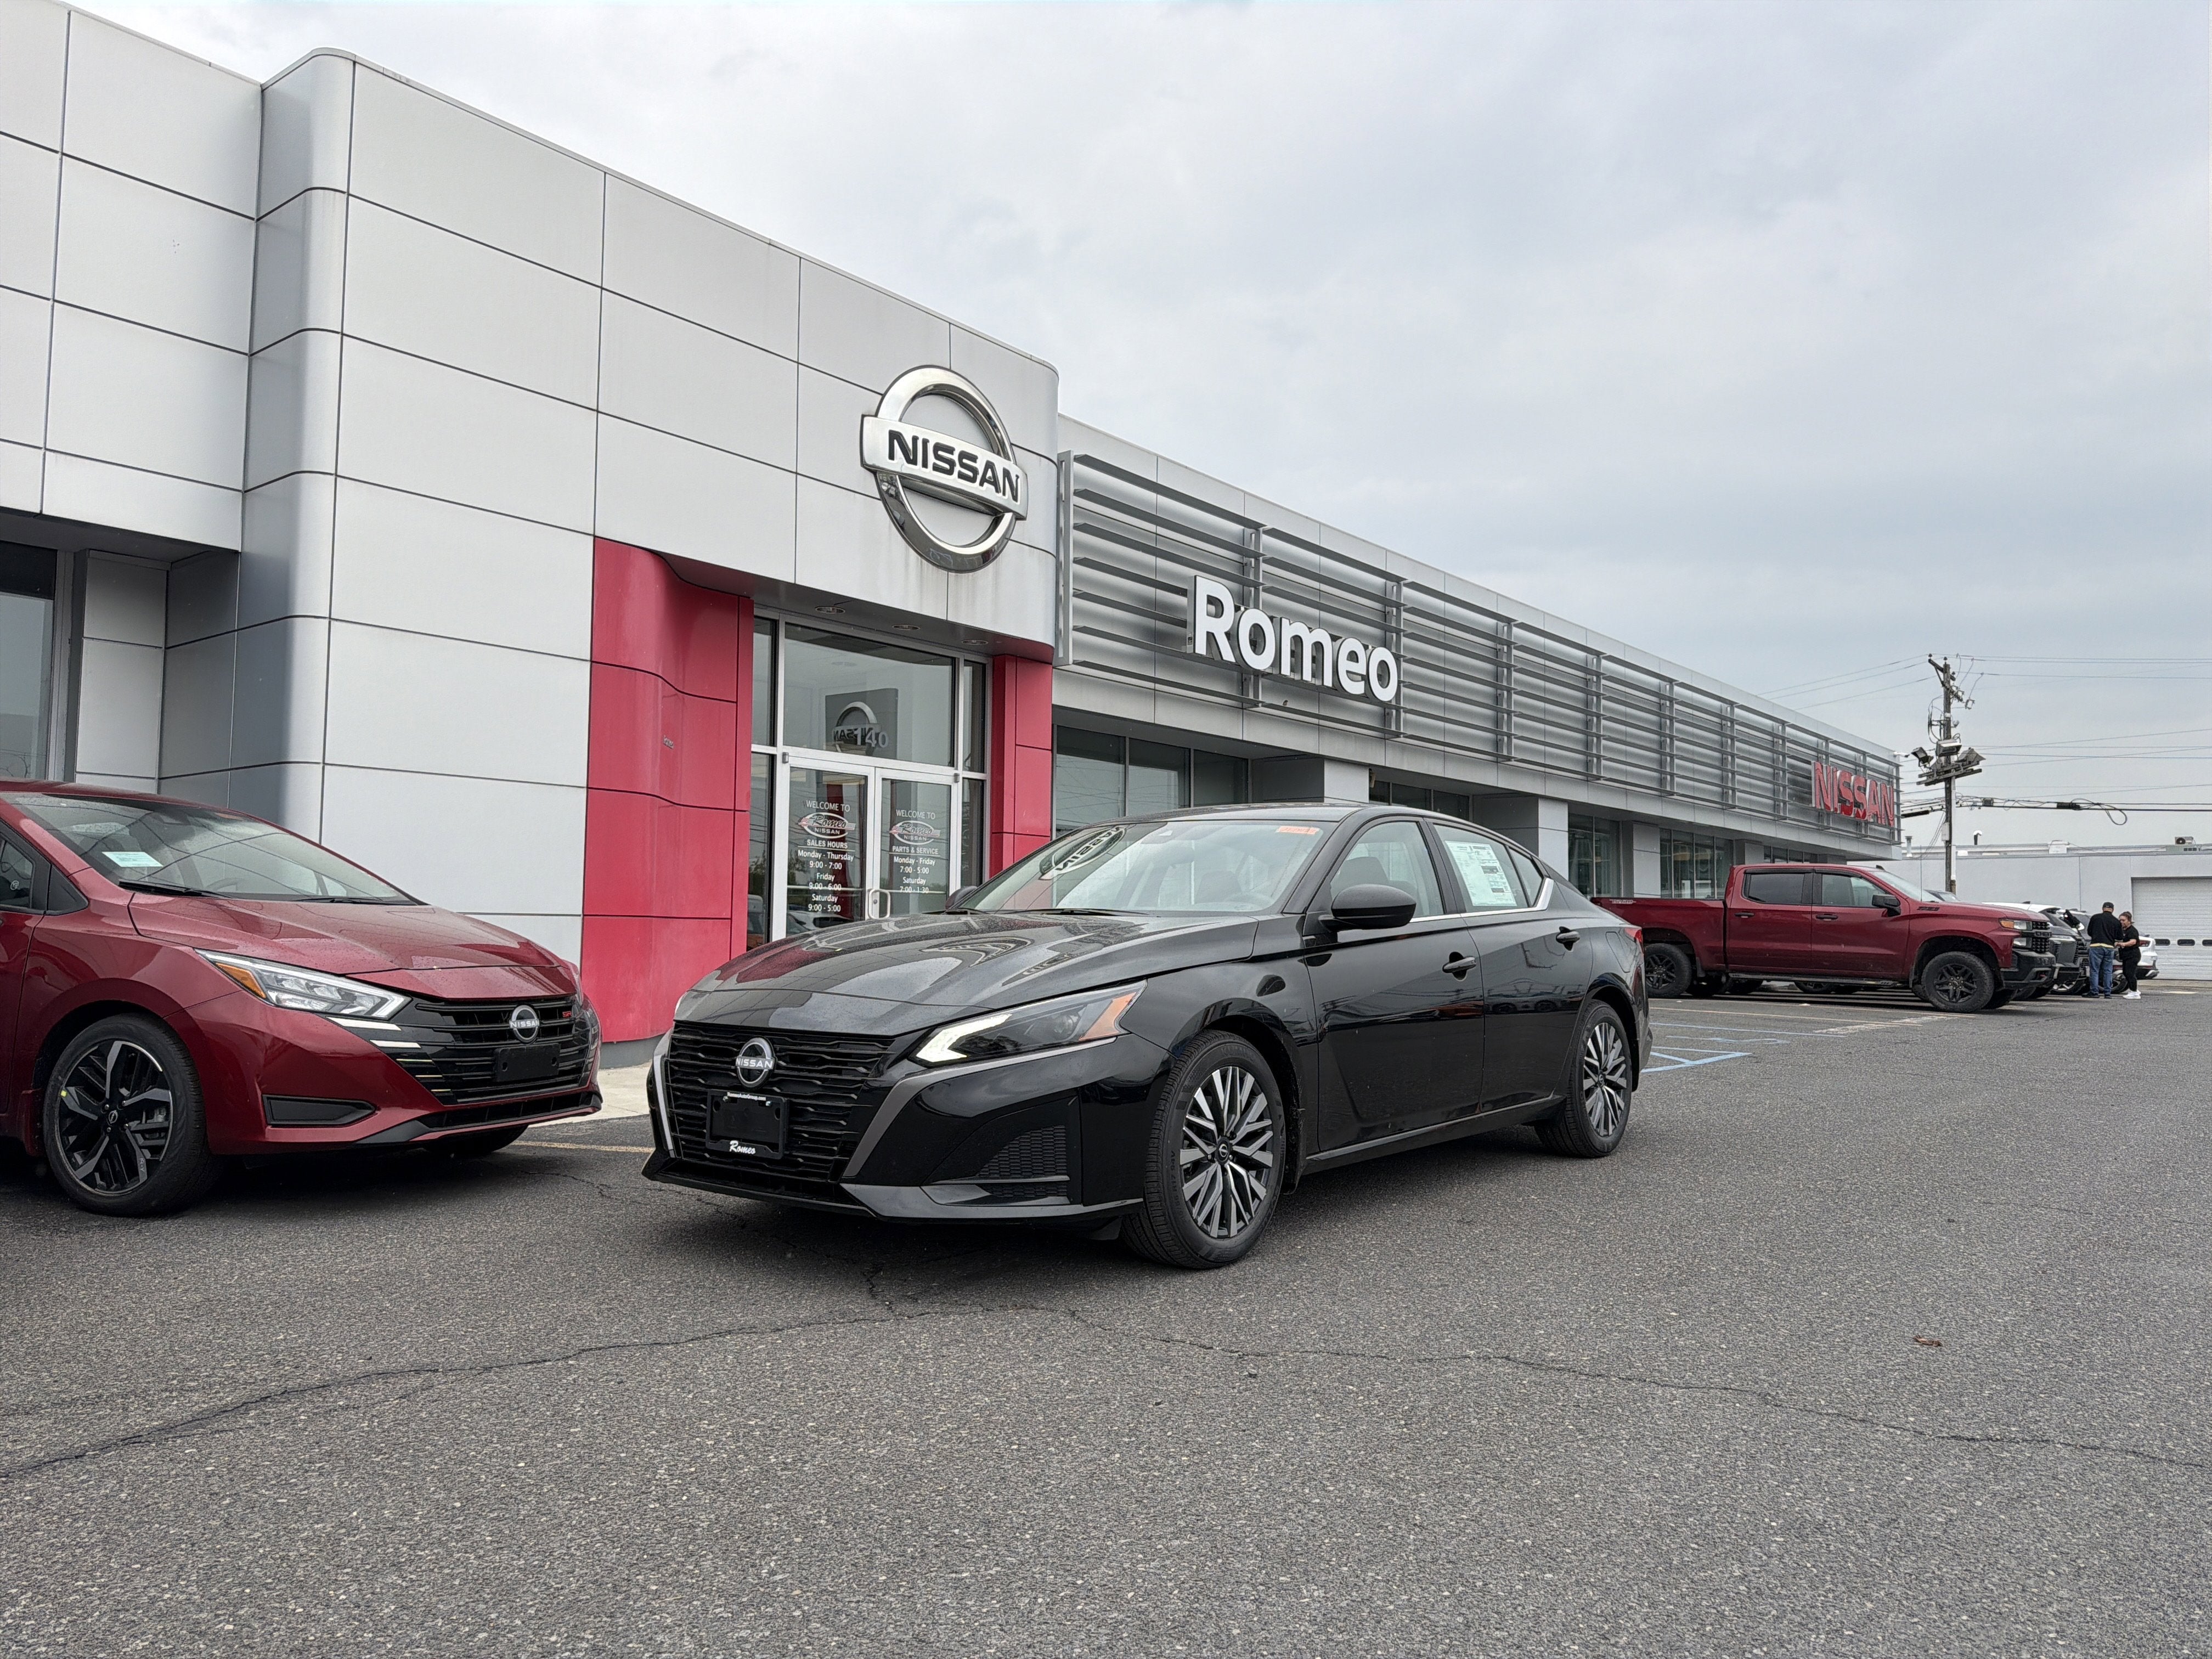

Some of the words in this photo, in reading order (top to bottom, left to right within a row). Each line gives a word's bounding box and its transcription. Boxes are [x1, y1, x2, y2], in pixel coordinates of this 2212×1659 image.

[888, 429, 1020, 503] NISSAN
[1194, 575, 1398, 702] Romeo
[854, 727, 889, 748] 140
[1813, 761, 1895, 827] NISSAN
[806, 800, 839, 811] WELCOME
[840, 804, 850, 812] TO
[896, 809, 926, 819] WELCOME
[811, 814, 847, 828] Romeo
[900, 822, 933, 834] Romeo
[806, 839, 826, 847] SALES
[827, 840, 848, 849] HOURS
[798, 849, 822, 859] Monday
[827, 851, 854, 861] Thursday
[894, 856, 915, 865] Monday
[919, 857, 935, 866] Friday
[816, 872, 835, 882] Friday
[902, 877, 926, 885] Saturday
[812, 893, 838, 903] Saturday
[736, 1057, 774, 1069] NISSAN
[729, 1140, 756, 1155] Romeo
